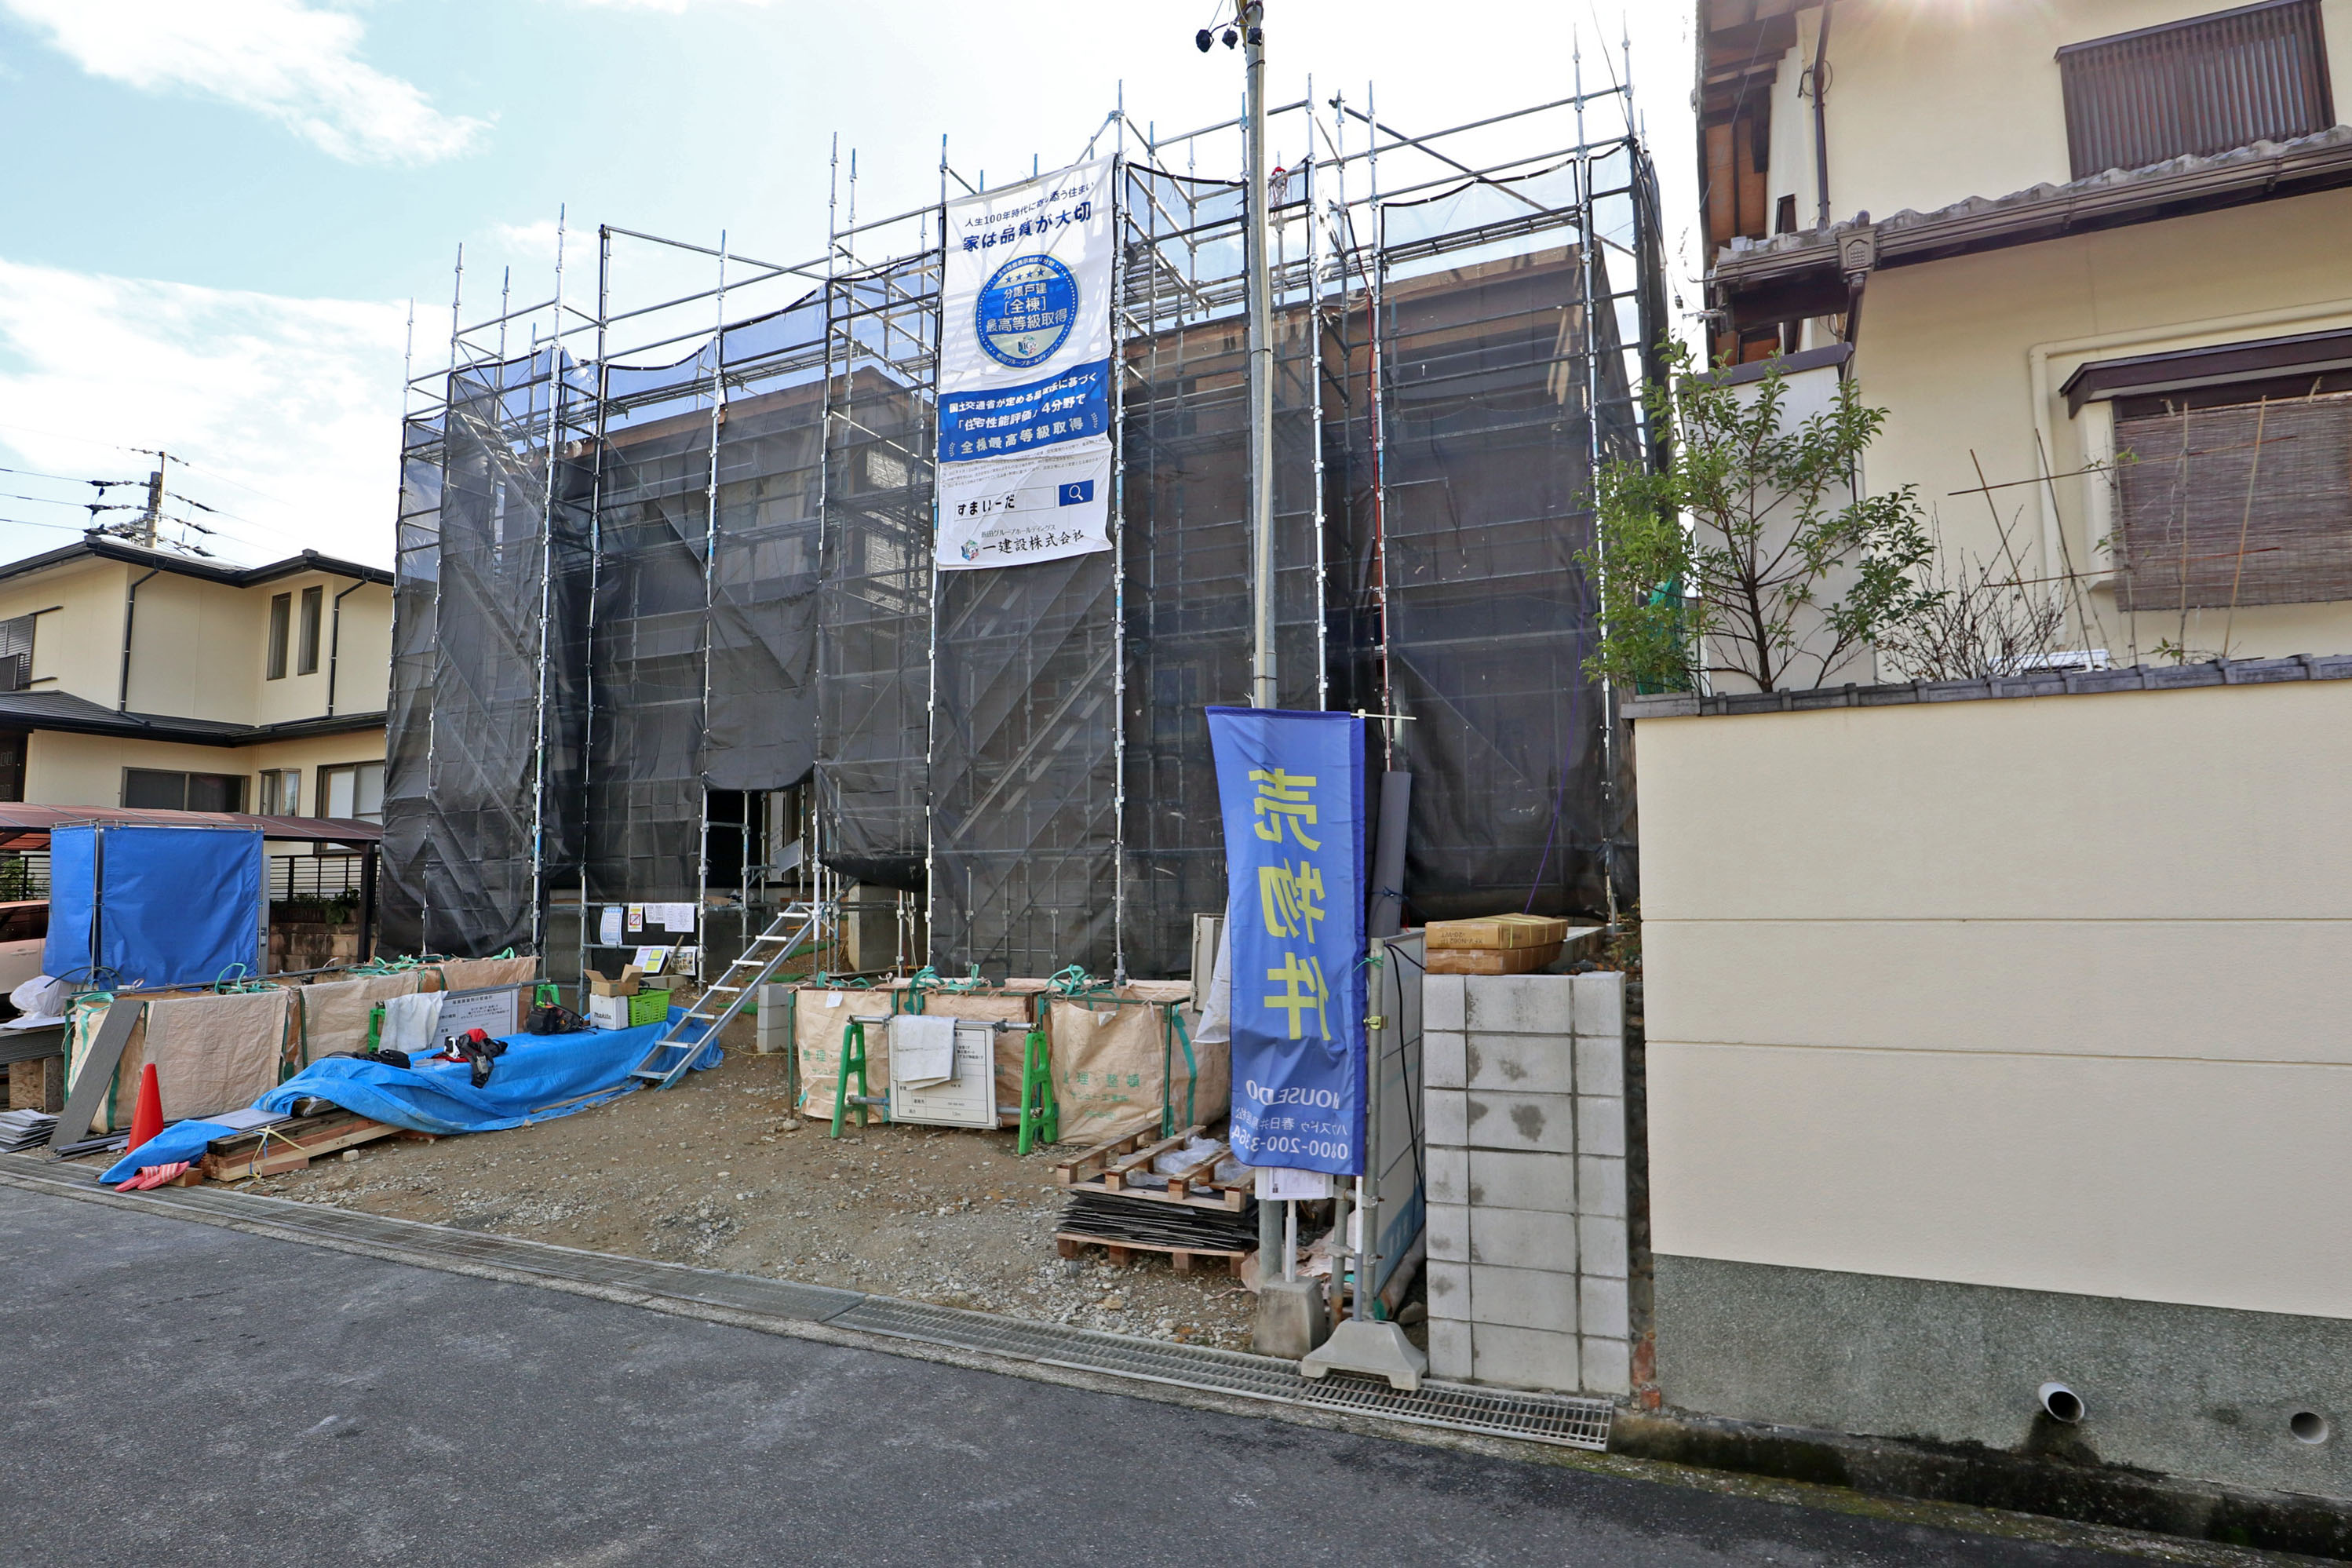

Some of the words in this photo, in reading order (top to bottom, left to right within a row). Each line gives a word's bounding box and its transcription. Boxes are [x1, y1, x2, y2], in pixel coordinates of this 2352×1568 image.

[963, 201, 1092, 253] 家は品質が大切
[1004, 282, 1048, 300] 分譲戸建
[986, 308, 1068, 334] 最高等級取得
[957, 494, 1016, 516] すまいーだ
[983, 528, 1085, 554] 一建設株式会社
